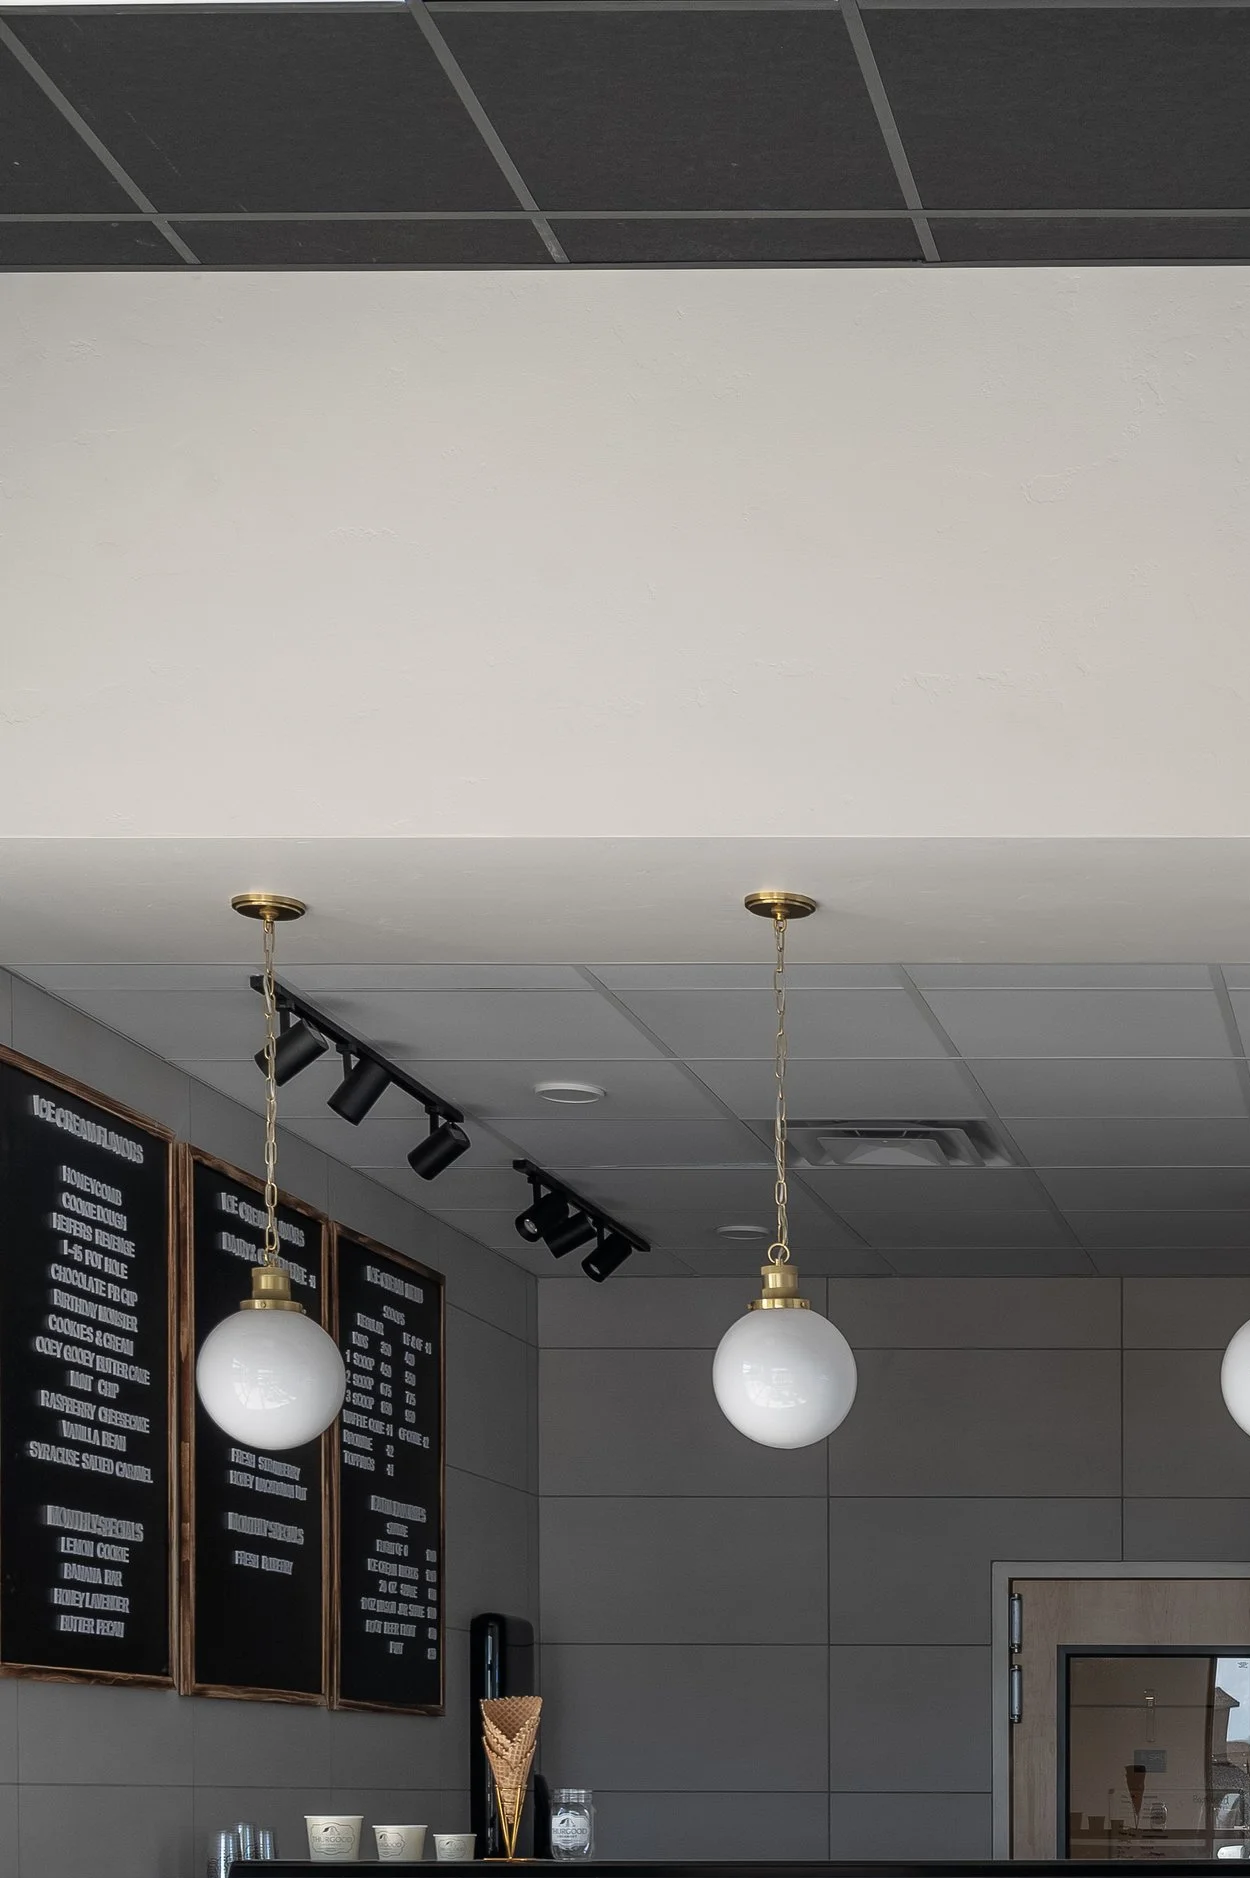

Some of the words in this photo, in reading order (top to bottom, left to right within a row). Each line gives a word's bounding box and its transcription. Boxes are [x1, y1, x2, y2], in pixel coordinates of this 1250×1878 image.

[33, 1095, 56, 1123] ICE
[56, 1108, 97, 1143] CREAM
[97, 1125, 144, 1164] FLAVORS
[62, 1165, 122, 1206] HONEYCOMB
[62, 1192, 97, 1220] COOKIE
[97, 1205, 127, 1231] DOUGH
[221, 1192, 238, 1214] ICE
[52, 1212, 92, 1242] HEIFERS
[95, 1228, 135, 1258] REVENGE
[50, 1263, 106, 1297] CHOCOLATE
[84, 1249, 104, 1269] POT
[104, 1257, 128, 1279] HOLE
[53, 1288, 98, 1320] BIRTHDAY
[98, 1305, 138, 1333] MONSTER
[49, 1314, 94, 1343] COOKIES
[95, 1330, 103, 1347] &
[103, 1332, 134, 1356] CREAM
[64, 1344, 95, 1368] GOOEY
[96, 1355, 129, 1379] BUTTER
[129, 1365, 150, 1386] CAKE
[40, 1389, 97, 1421] RASPBERRY
[97, 1379, 120, 1399] CHIP
[62, 1420, 100, 1446] VANILLA
[102, 1430, 127, 1452] BEAN
[29, 1441, 80, 1468] SYRACUSE
[82, 1452, 114, 1475] SALTED
[61, 1536, 94, 1557] LEMON
[96, 1542, 130, 1563] COOKIE
[64, 1562, 102, 1584] BANANA
[54, 1588, 85, 1608] HONEY
[85, 1592, 130, 1614] LAVENDER
[60, 1614, 95, 1634] BUTTER
[96, 1619, 124, 1638] PECAN
